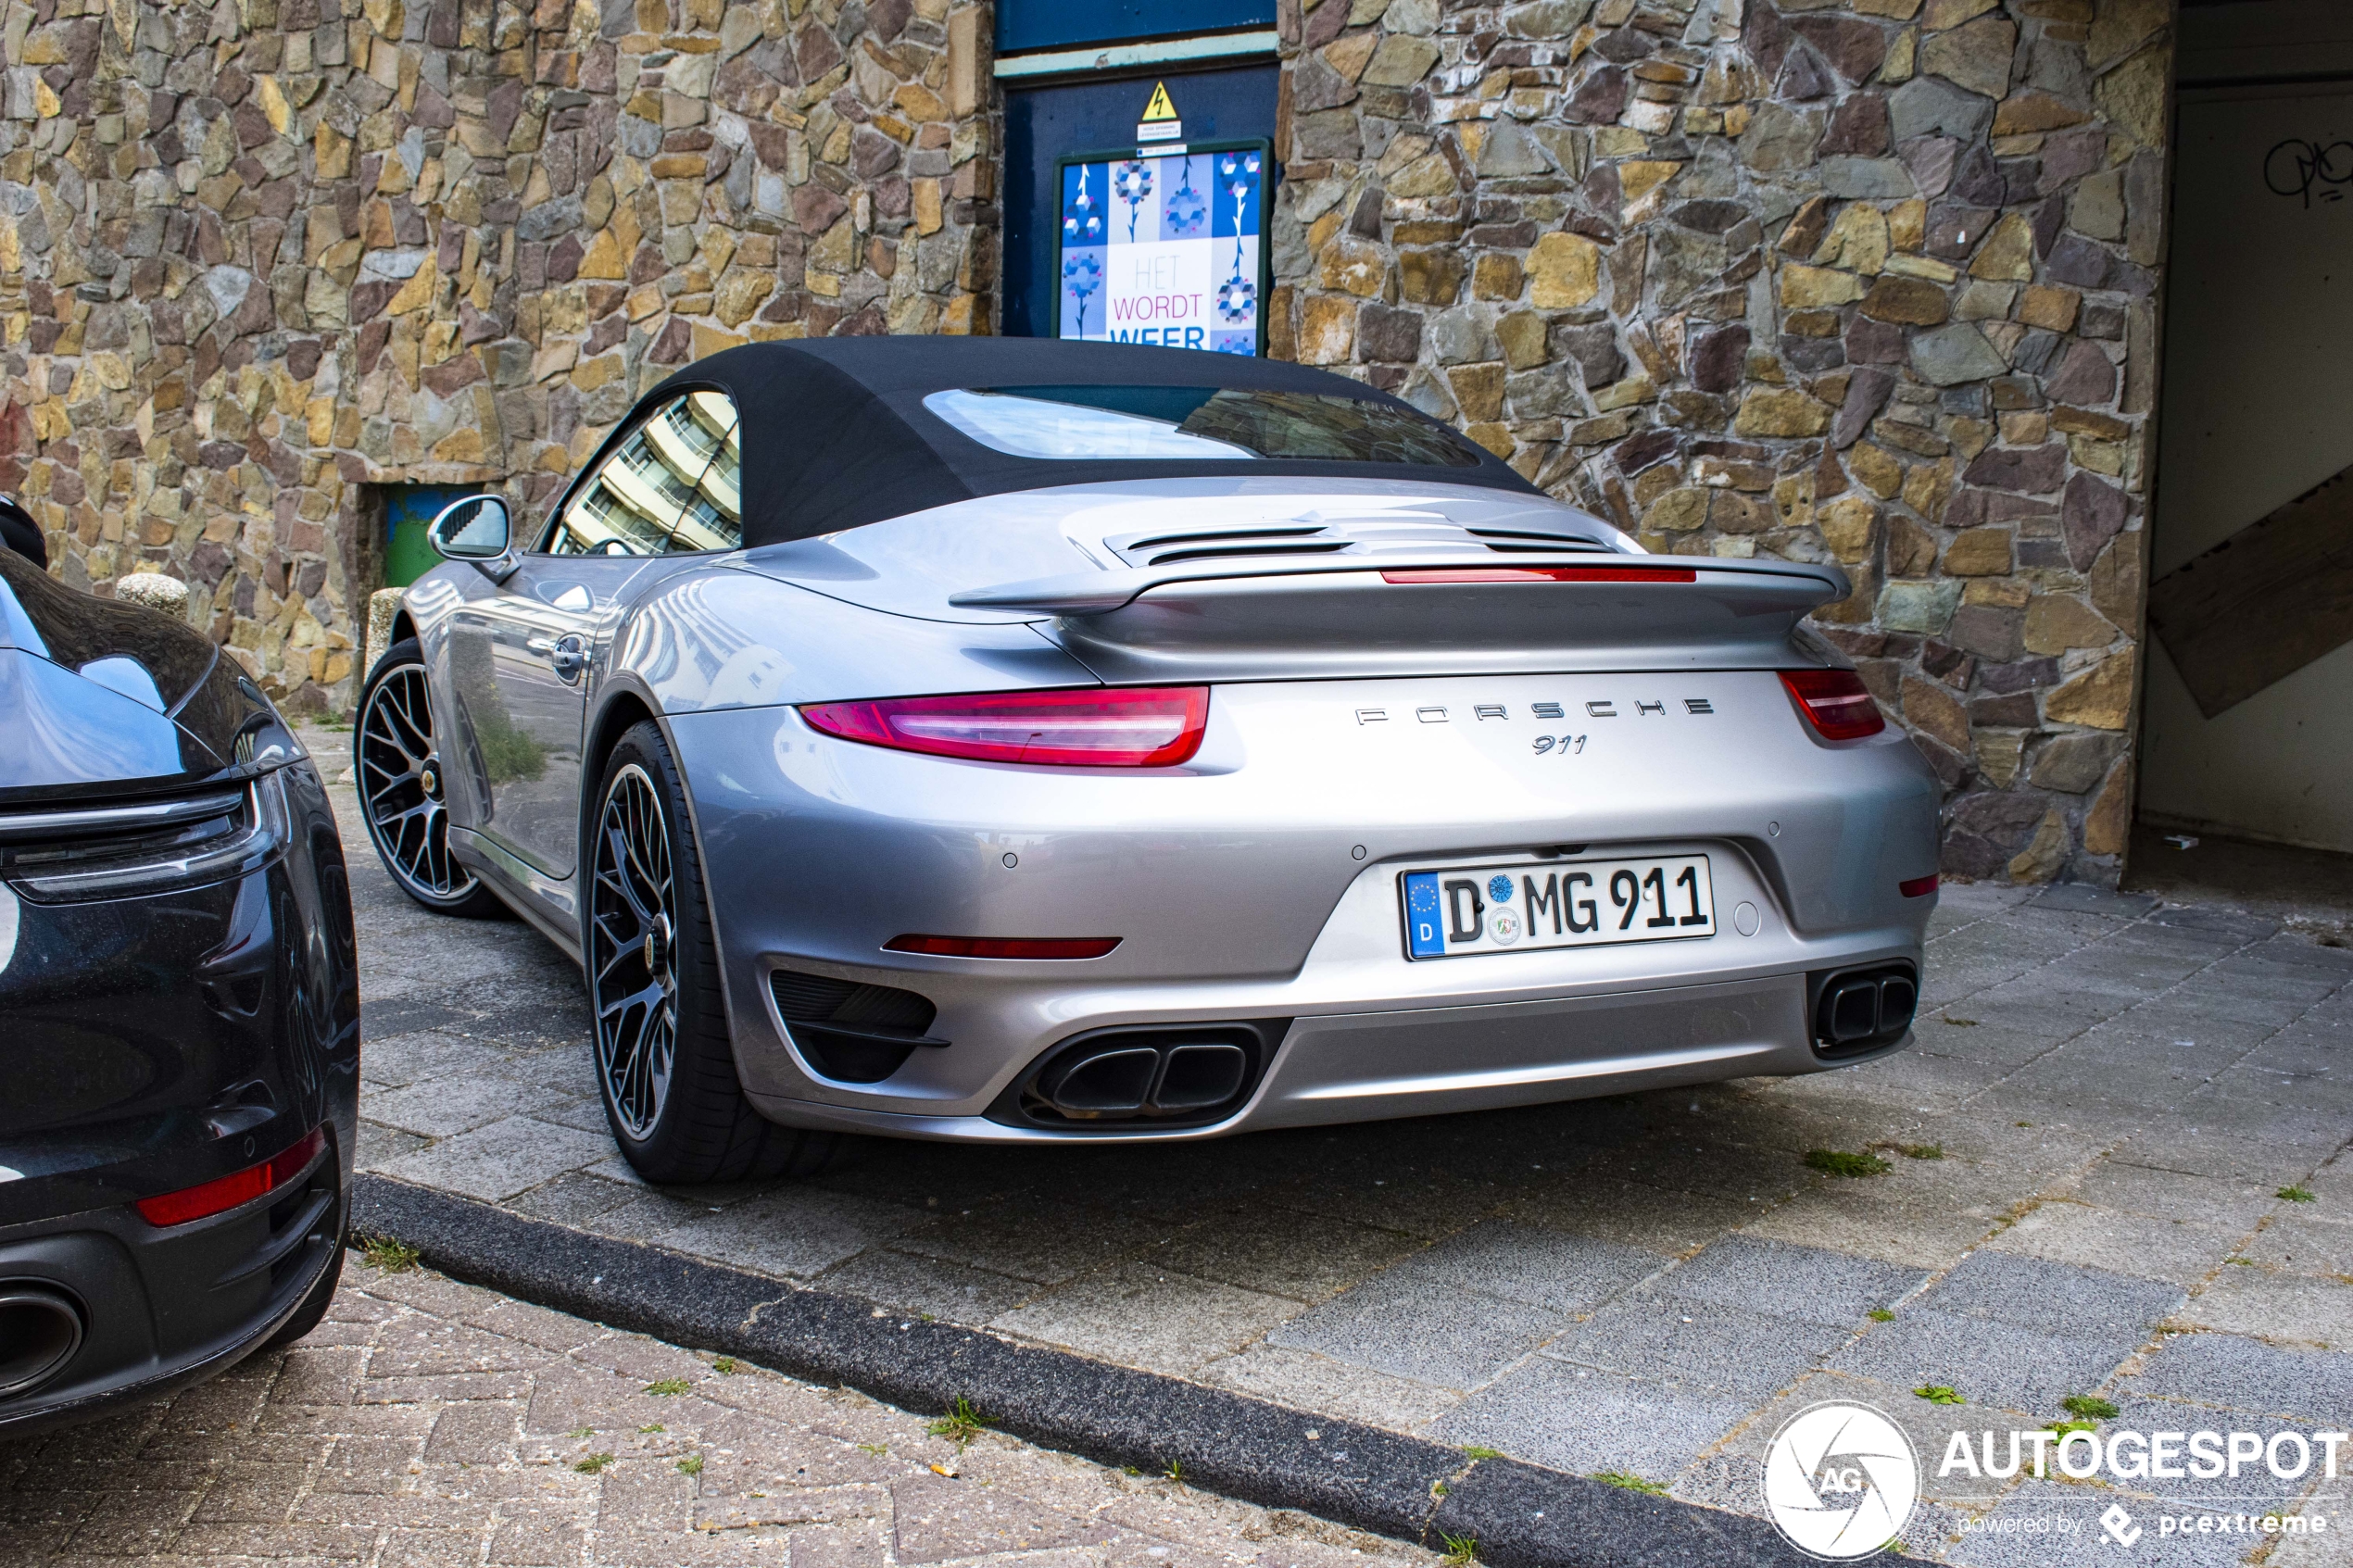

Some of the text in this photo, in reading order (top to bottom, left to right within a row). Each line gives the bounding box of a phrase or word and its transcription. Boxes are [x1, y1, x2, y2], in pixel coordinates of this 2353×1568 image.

[1135, 255, 1181, 290] HET
[1114, 294, 1203, 320] WORDT
[1355, 698, 1714, 725] PORSCHE
[1531, 734, 1587, 755] 911
[1443, 878, 1484, 943] D
[1609, 866, 1708, 930] 911
[1419, 922, 1433, 942] D
